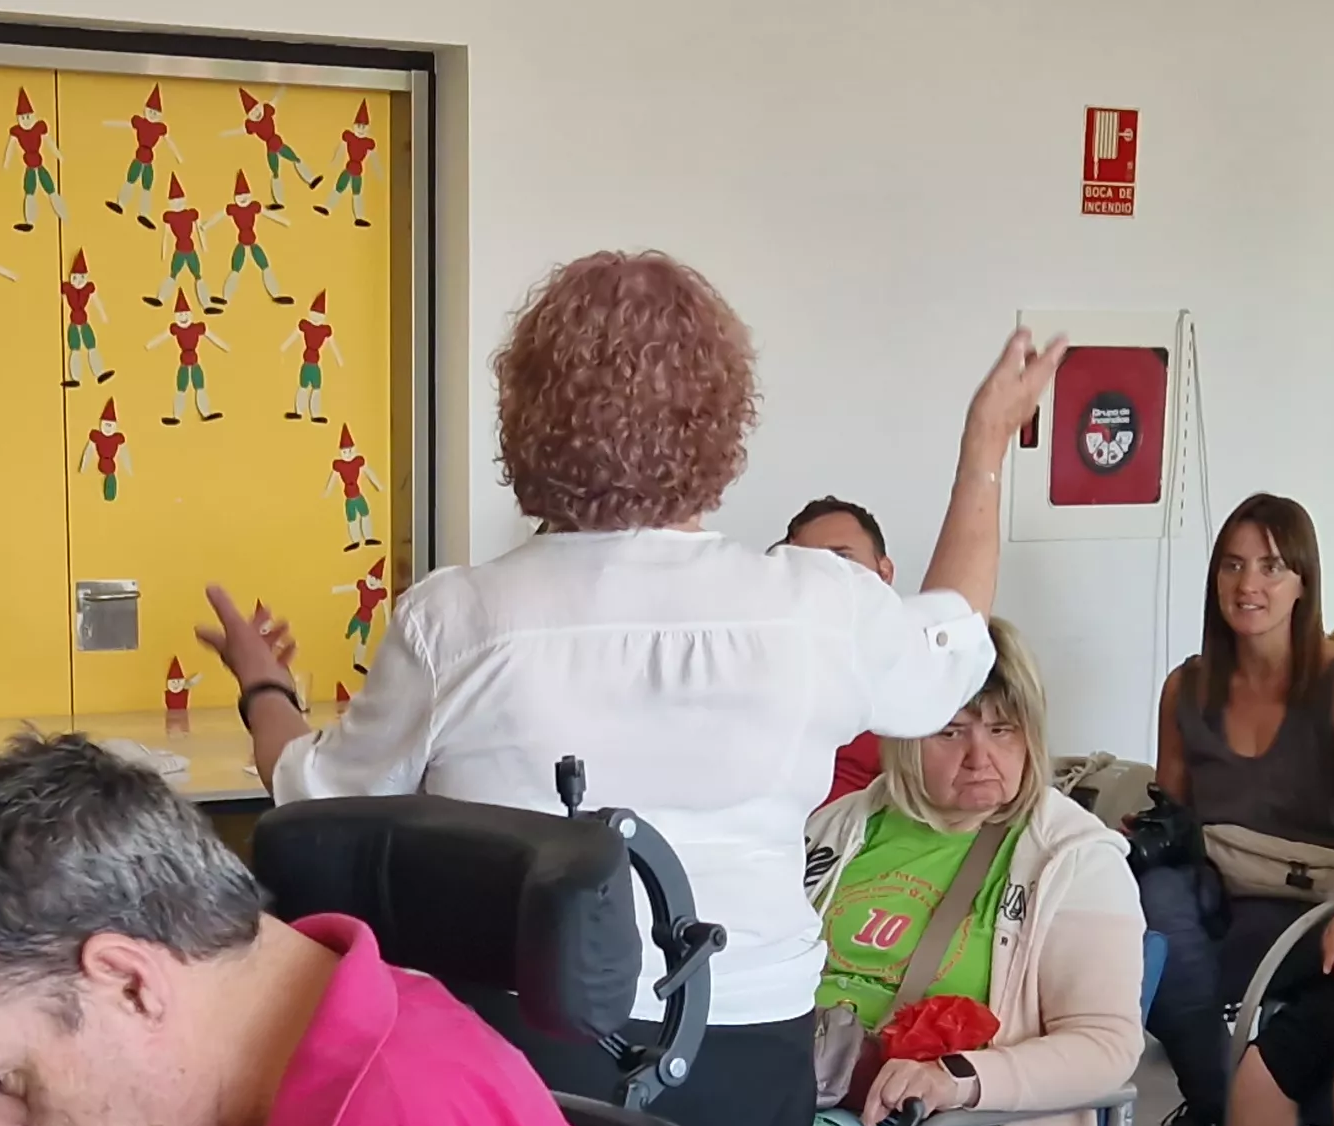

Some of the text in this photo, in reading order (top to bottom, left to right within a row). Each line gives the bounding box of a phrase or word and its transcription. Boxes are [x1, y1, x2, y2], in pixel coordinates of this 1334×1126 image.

[1085, 186, 1132, 199] BOCA DE
[1084, 201, 1132, 213] INCENDIO
[851, 907, 912, 950] 10
